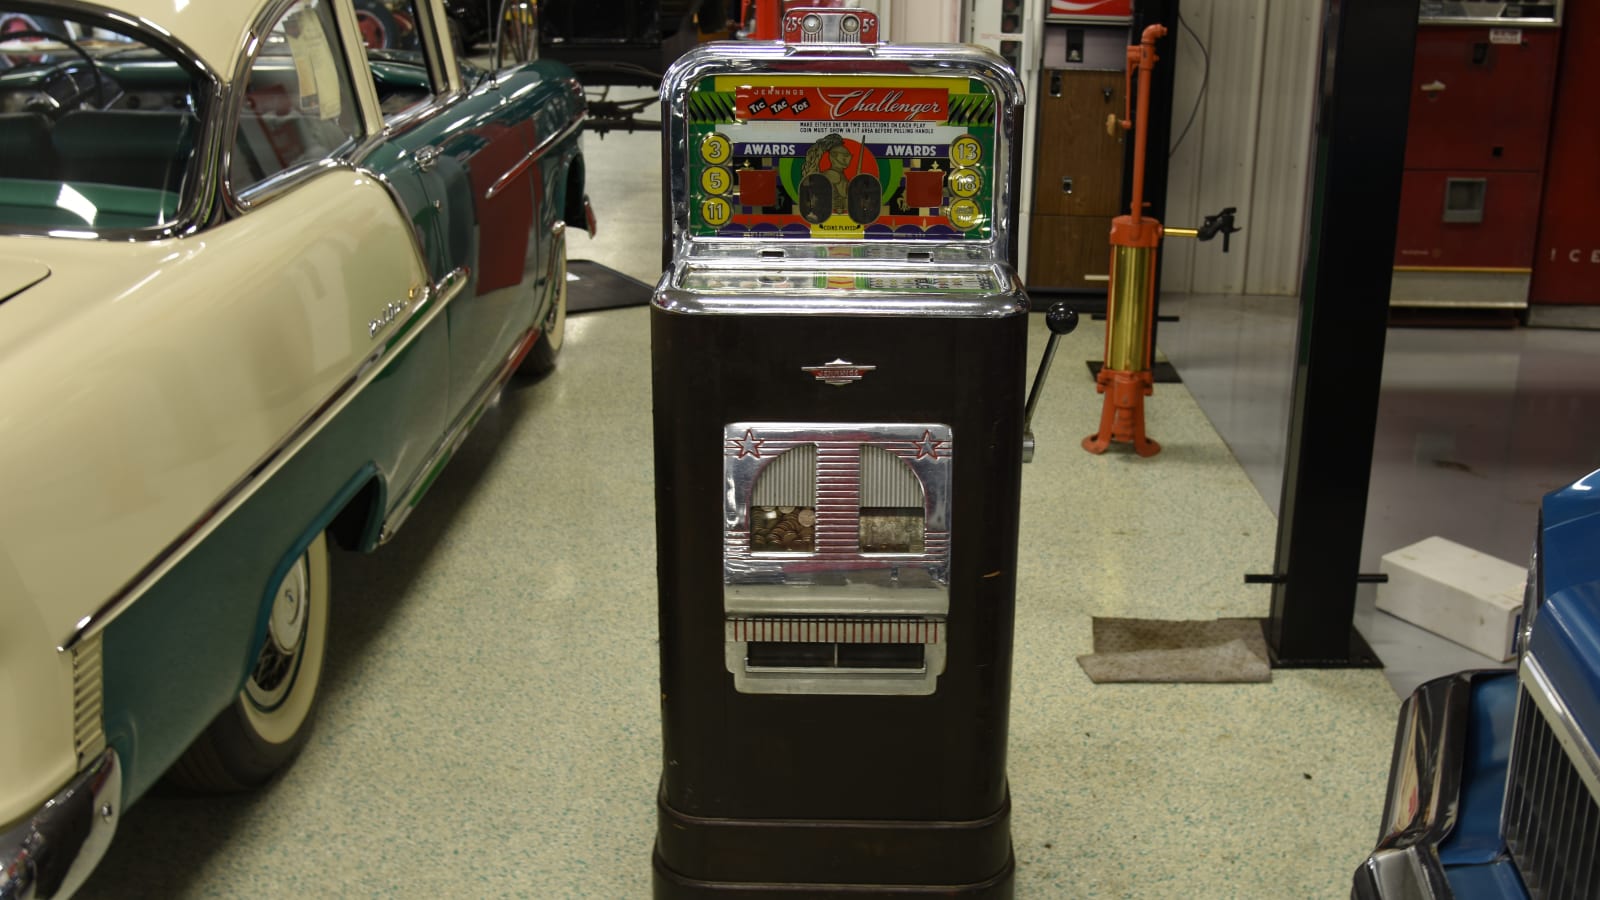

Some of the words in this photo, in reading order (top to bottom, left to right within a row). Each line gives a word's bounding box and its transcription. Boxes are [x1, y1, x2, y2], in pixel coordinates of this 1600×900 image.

[749, 101, 766, 113] TIC
[770, 100, 788, 113] TAC
[791, 100, 809, 113] TOE
[817, 88, 941, 120] Challenger
[710, 141, 721, 158] 3
[744, 144, 795, 155] AWARDS
[885, 145, 936, 156] AWARDS
[958, 143, 978, 161] 13
[709, 172, 721, 189] 5
[708, 203, 723, 219] 11
